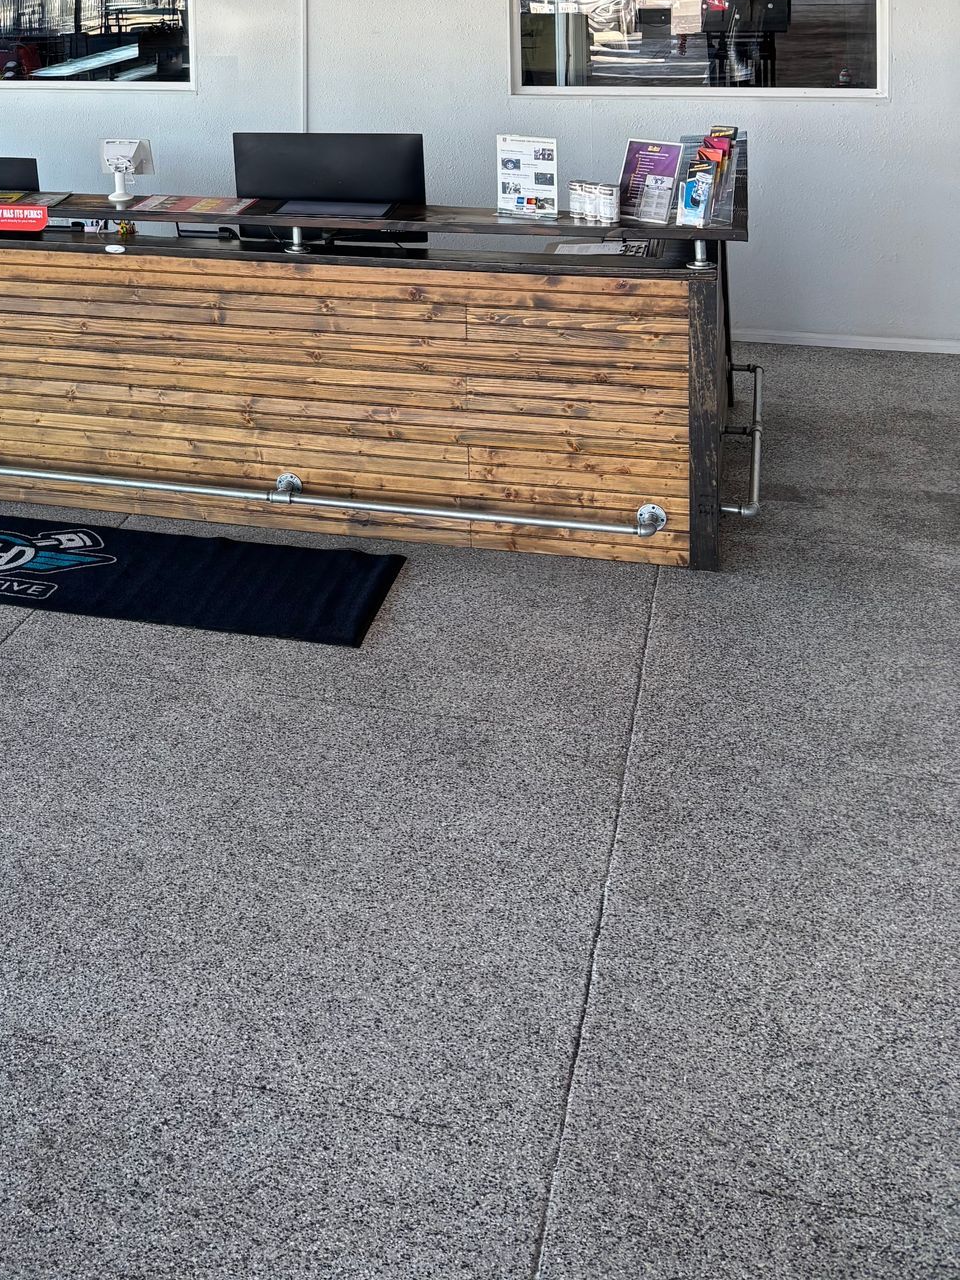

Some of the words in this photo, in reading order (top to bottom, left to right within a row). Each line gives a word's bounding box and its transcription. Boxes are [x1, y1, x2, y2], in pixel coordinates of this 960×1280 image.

[3, 209, 13, 218] HAS
[14, 209, 23, 218] ITS
[24, 209, 43, 219] PERKS!
